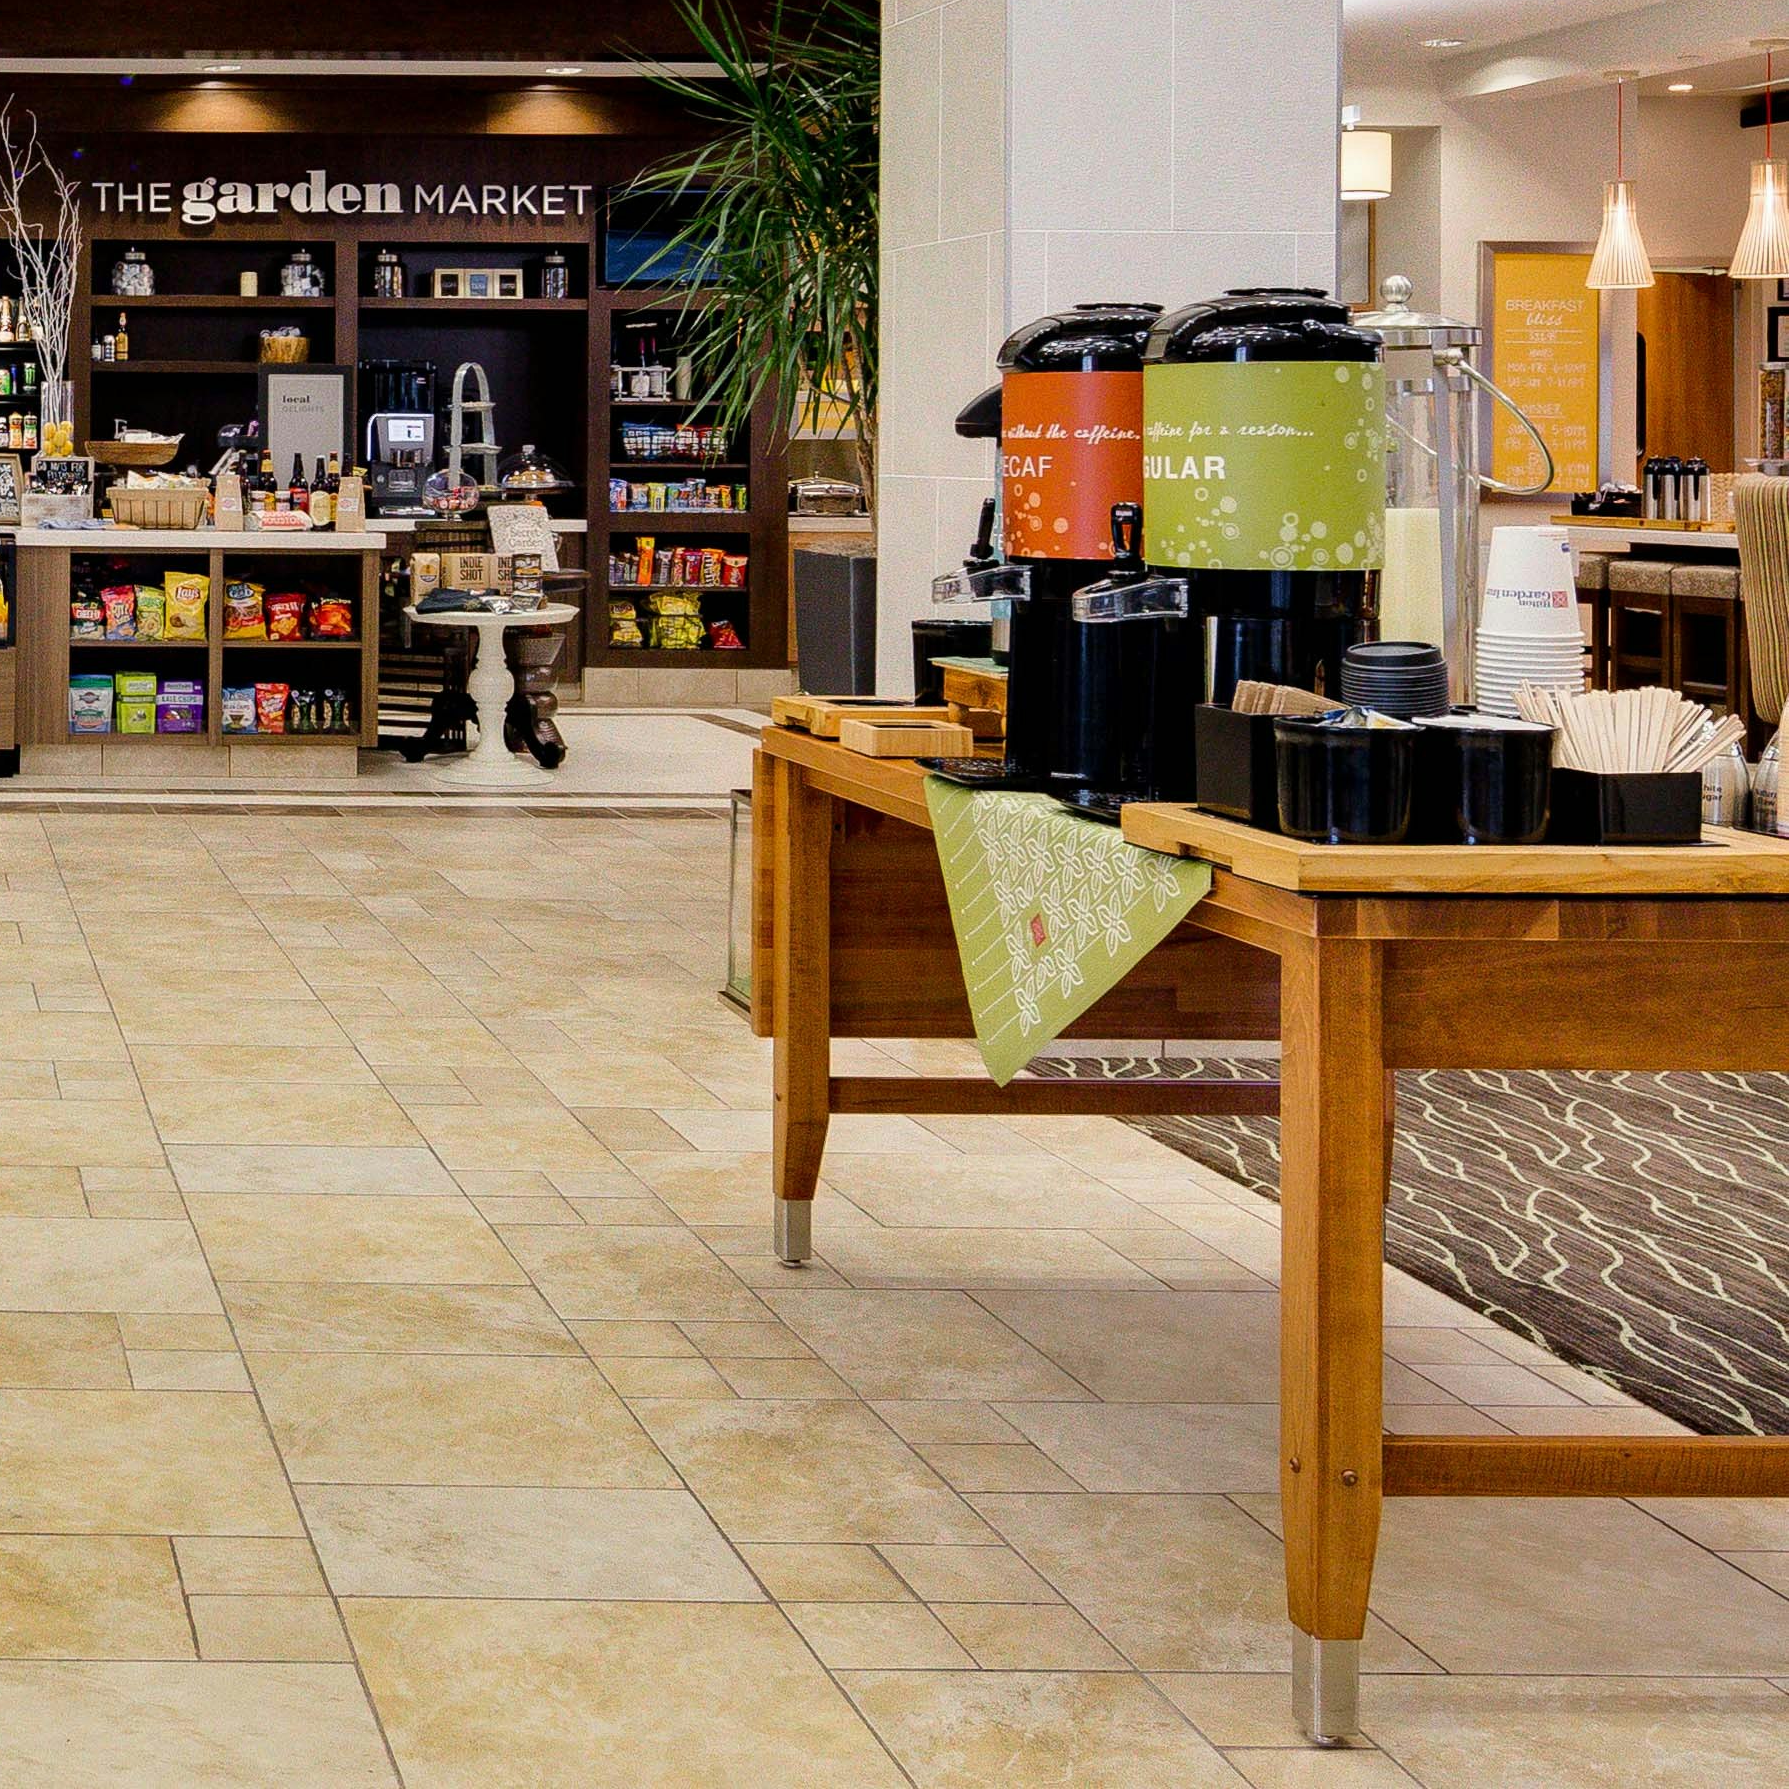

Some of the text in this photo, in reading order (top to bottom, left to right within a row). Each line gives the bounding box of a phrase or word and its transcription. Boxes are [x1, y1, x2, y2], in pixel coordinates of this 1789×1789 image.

[91, 169, 593, 225] THE garden MARKET
[1505, 299, 1585, 313] BREAKFAST
[1525, 312, 1564, 326] bliss
[281, 394, 311, 404] local
[1045, 423, 1068, 439] the
[1073, 424, 1141, 445] caffeine.
[1144, 421, 1315, 443] affeine for a reason...
[35, 460, 48, 472] GO
[70, 461, 86, 472] FOR
[1002, 455, 1054, 478] ECAF
[1142, 454, 1227, 480] GULAR
[509, 526, 540, 538] Secret
[508, 537, 544, 549] Garden
[459, 556, 484, 568] INDIE
[497, 556, 513, 568] IND
[459, 569, 484, 581] SHOT
[497, 569, 513, 581] SH
[175, 586, 201, 600] Lay's
[1502, 589, 1551, 601] Garden
[1518, 600, 1551, 608] Hilton
[1703, 784, 1722, 793] hite
